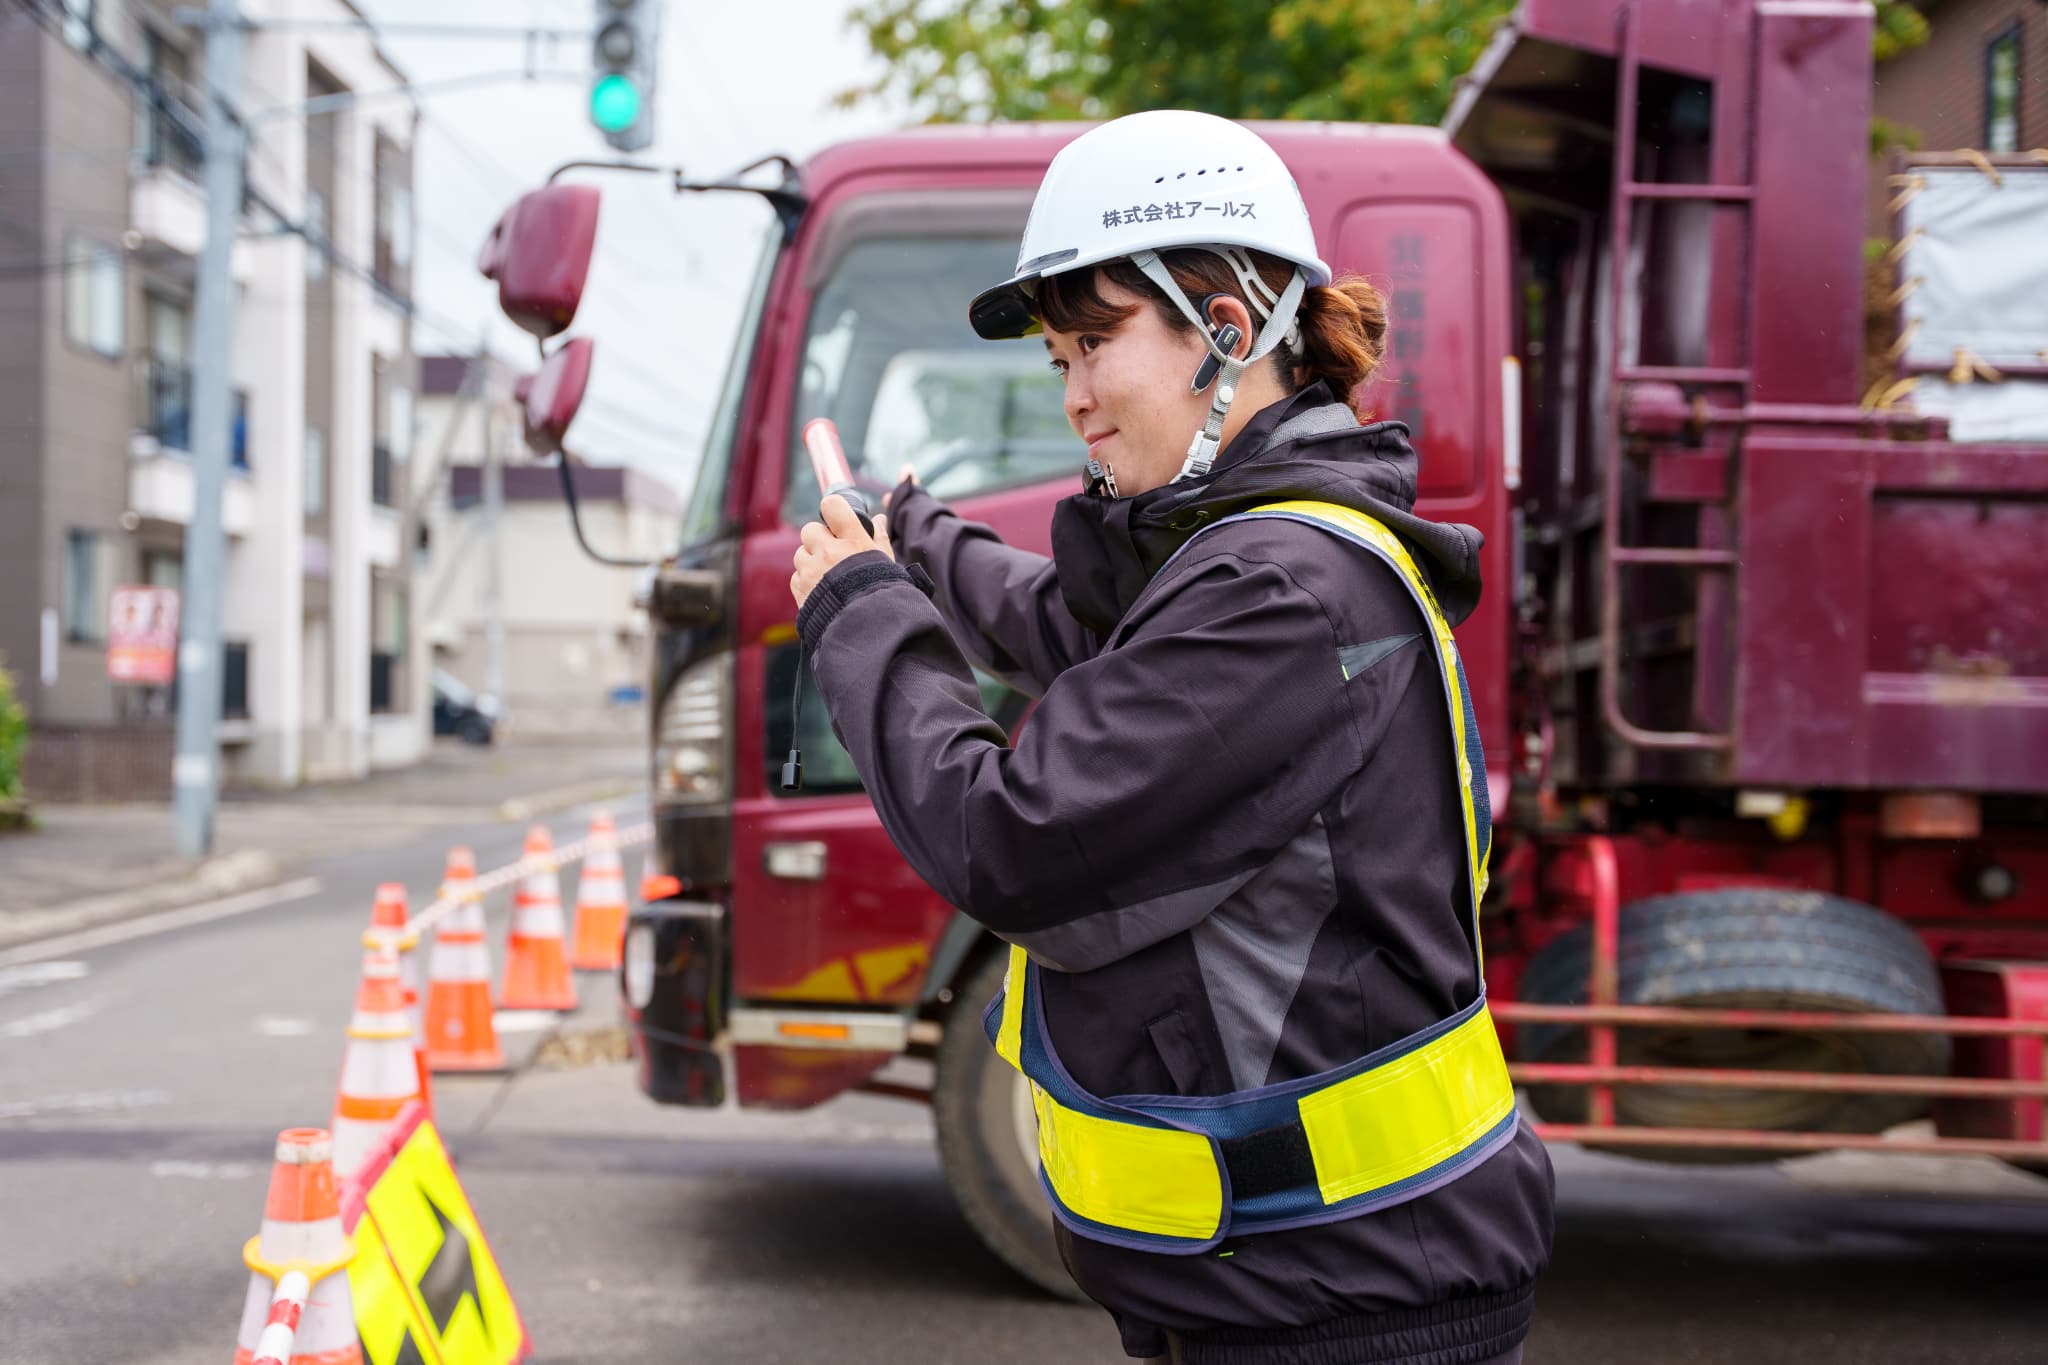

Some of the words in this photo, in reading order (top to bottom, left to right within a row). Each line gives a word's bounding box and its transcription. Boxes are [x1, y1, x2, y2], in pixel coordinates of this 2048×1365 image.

[1102, 201, 1257, 229] 株式会社アールズ
